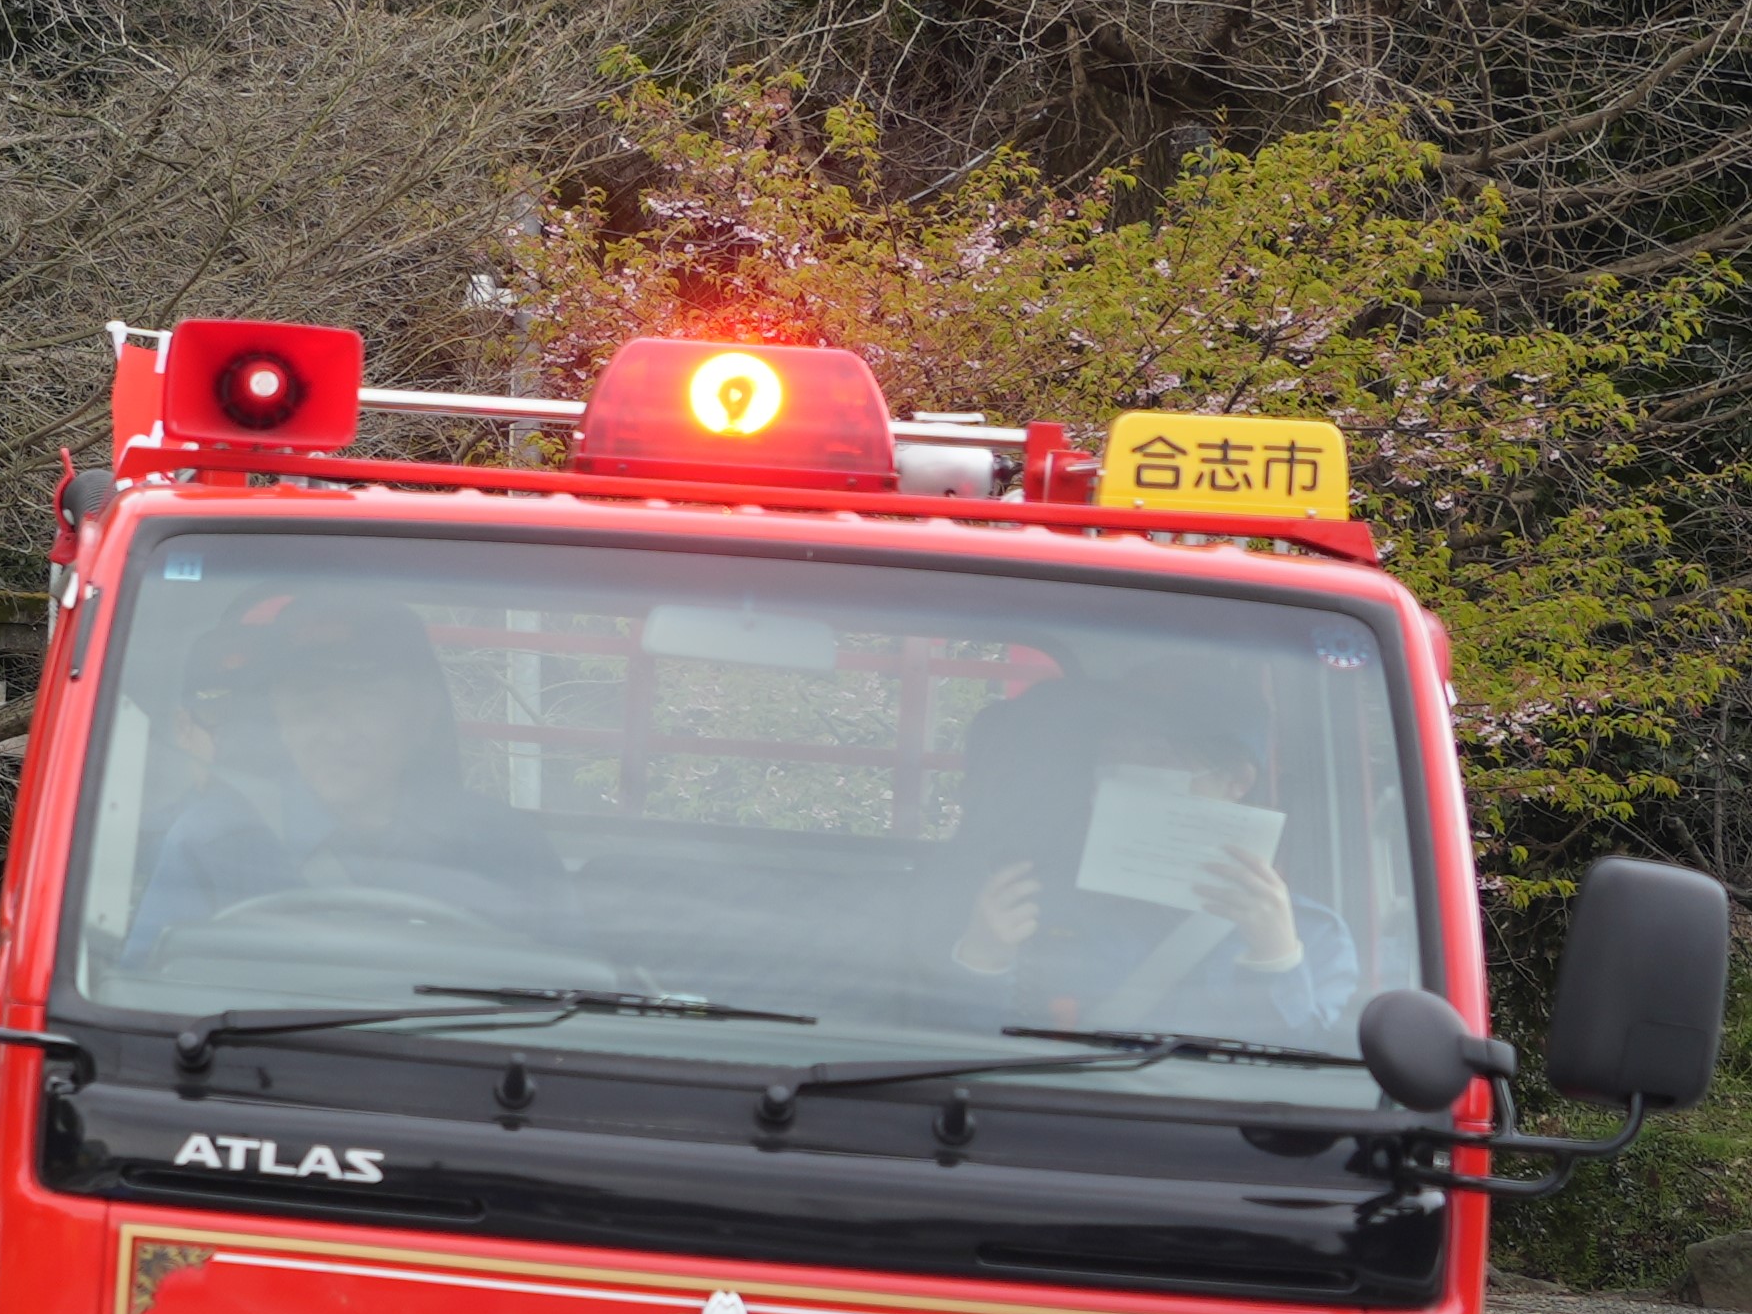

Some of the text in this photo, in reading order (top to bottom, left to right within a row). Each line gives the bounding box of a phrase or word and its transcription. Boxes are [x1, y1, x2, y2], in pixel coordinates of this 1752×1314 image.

[1131, 434, 1325, 496] 合志市
[173, 1132, 386, 1184] ATLAS
